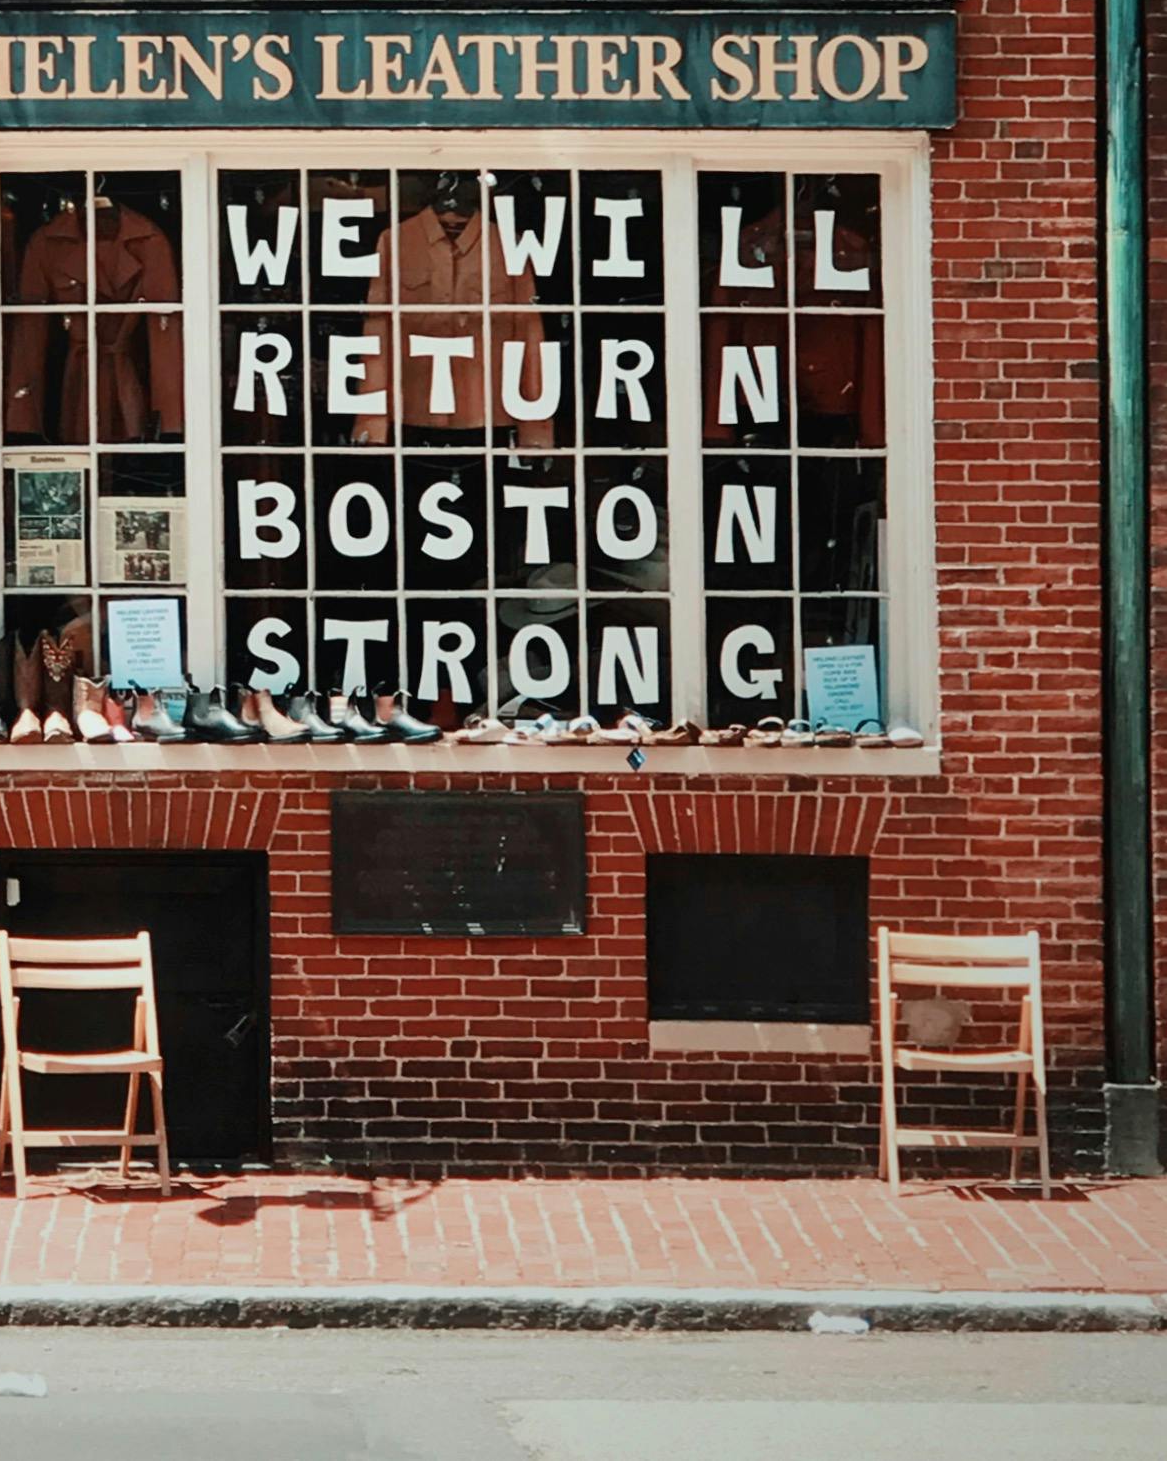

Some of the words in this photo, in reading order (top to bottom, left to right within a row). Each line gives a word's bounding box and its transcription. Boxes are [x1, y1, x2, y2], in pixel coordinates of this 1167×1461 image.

[314, 34, 690, 102] LEATHER
[709, 34, 929, 103] SHOP
[226, 197, 381, 287] WE
[494, 195, 870, 291] WILL
[233, 332, 779, 425] RETURN
[237, 479, 778, 565] BOSTON
[247, 617, 782, 704] STRONG
